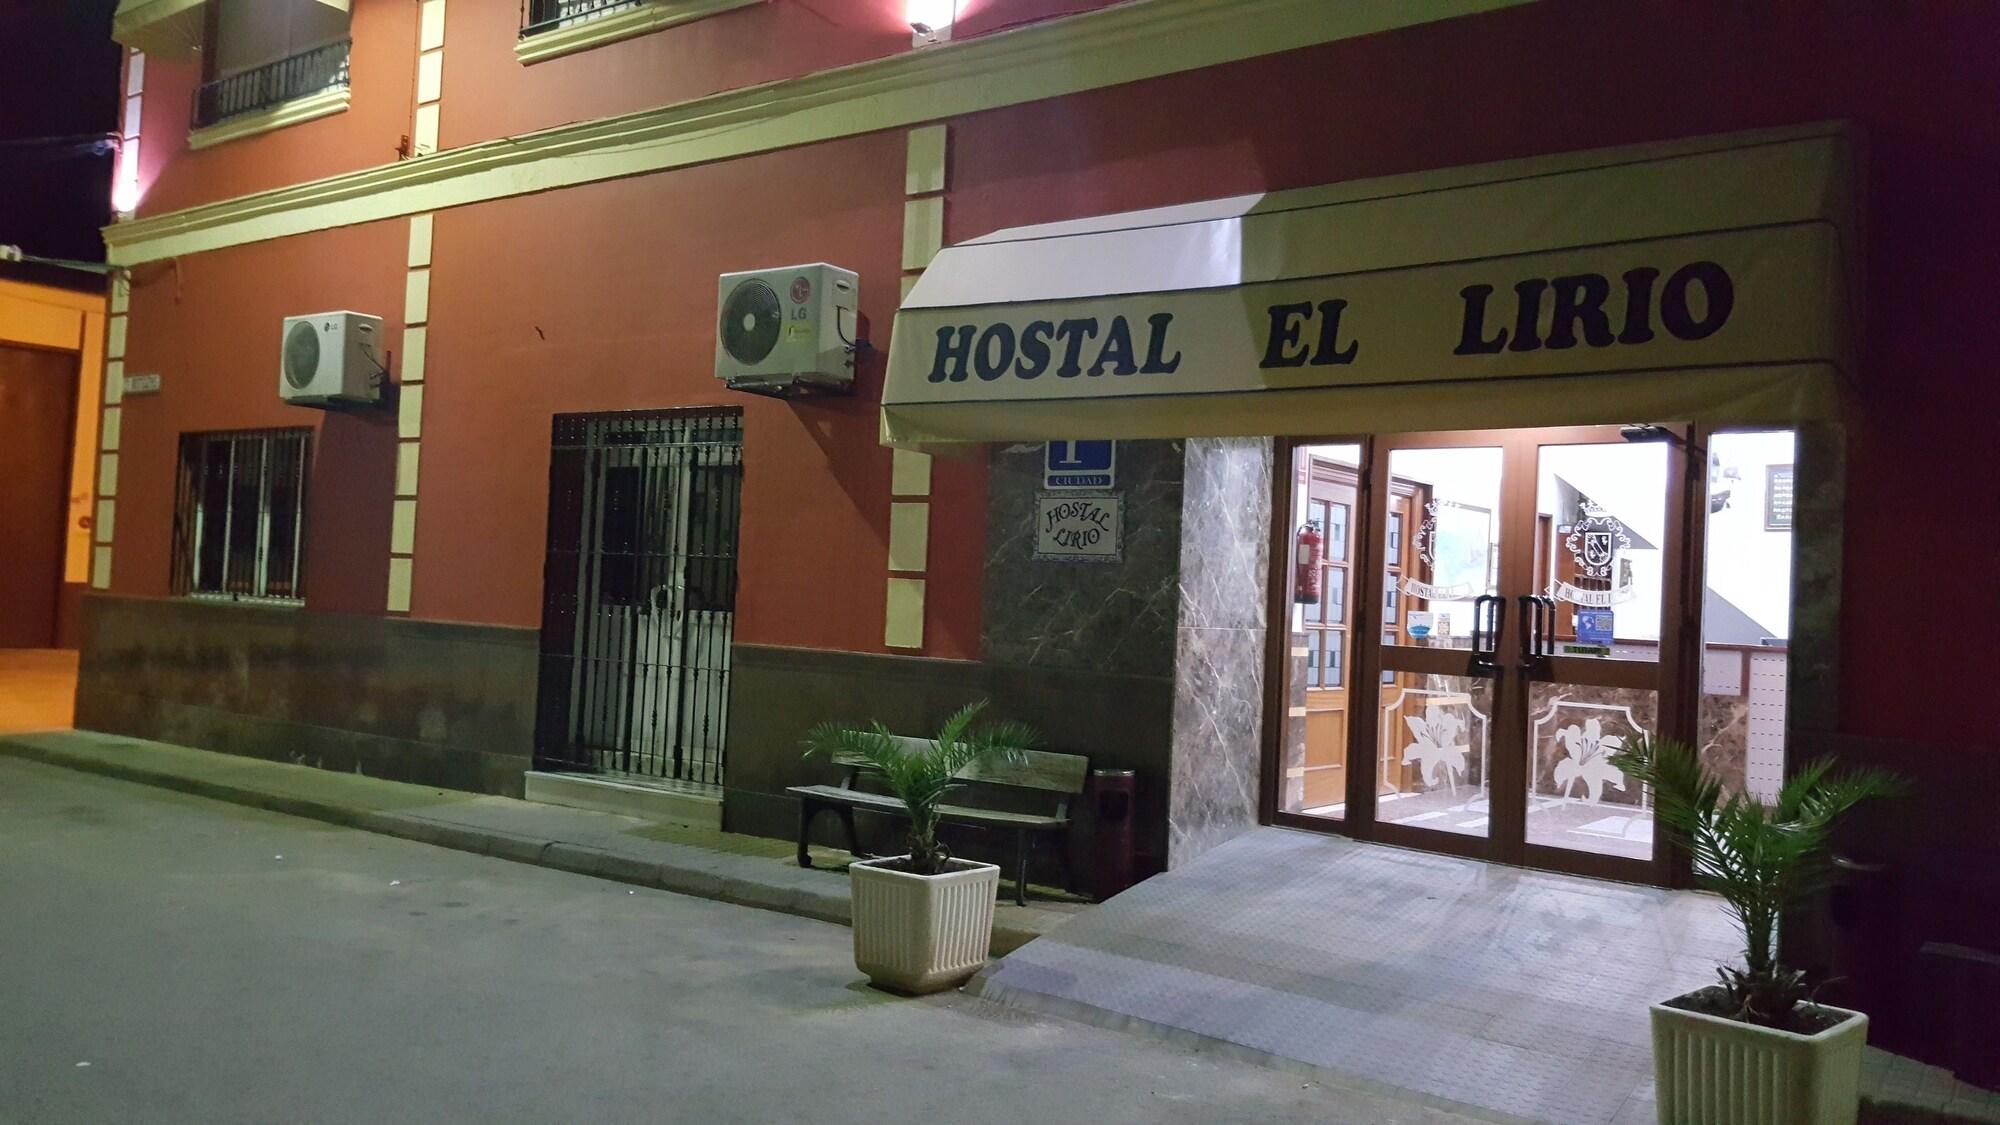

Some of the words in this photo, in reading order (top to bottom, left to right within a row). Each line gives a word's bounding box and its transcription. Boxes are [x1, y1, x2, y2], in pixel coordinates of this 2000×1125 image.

[791, 307, 807, 320] LG
[928, 313, 1181, 383] HOSTAL
[1259, 299, 1359, 369] EL
[1453, 261, 1734, 355] LIRIO
[1055, 477, 1102, 485] CIUDAD
[1045, 501, 1110, 533] HOSTAL
[1053, 528, 1100, 550] LIRIO
